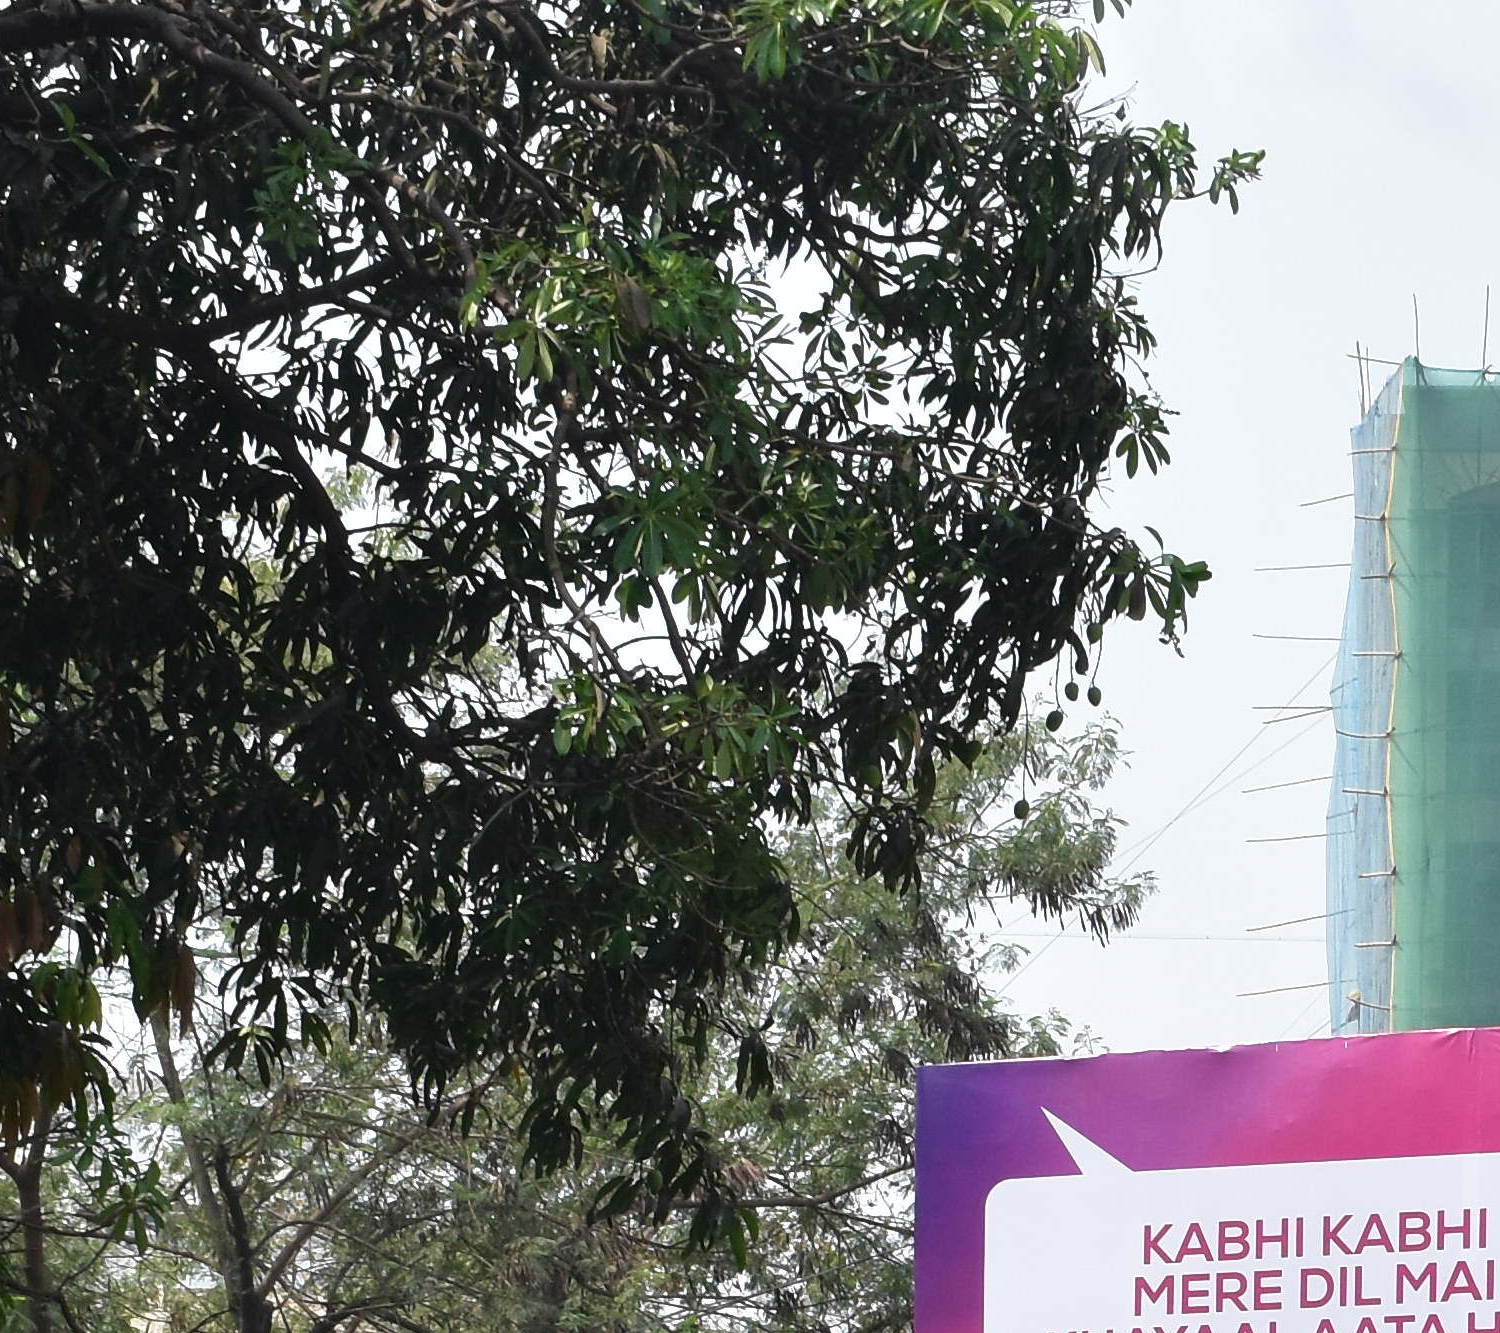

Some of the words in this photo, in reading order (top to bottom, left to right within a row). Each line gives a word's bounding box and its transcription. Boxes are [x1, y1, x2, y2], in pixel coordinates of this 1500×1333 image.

[1142, 1217, 1304, 1266] KABHI
[1319, 1207, 1490, 1256] KABHI
[1133, 1270, 1280, 1317] MERE
[1299, 1266, 1381, 1308] DIL
[1396, 1259, 1496, 1304] MAI
